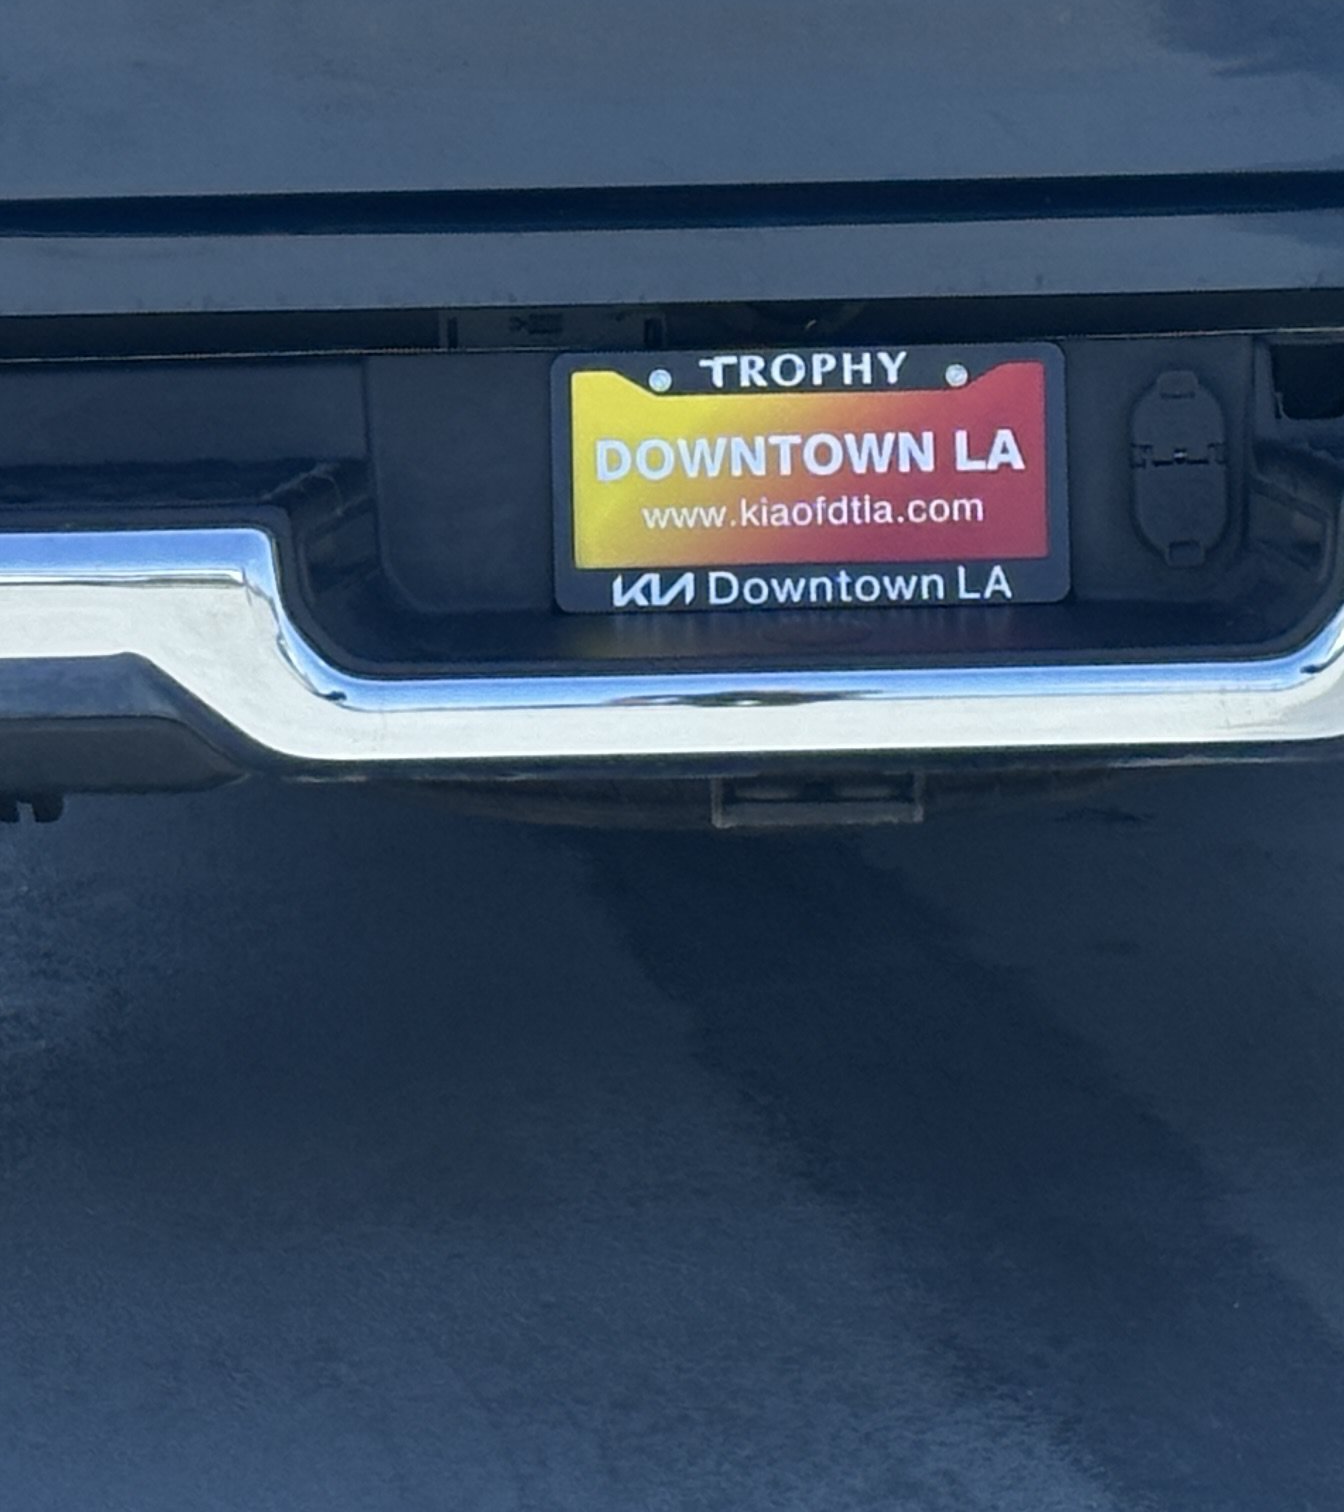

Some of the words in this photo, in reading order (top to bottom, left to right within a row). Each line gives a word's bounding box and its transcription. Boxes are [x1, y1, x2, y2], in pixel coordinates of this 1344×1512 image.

[699, 351, 907, 388] TROPHY
[596, 431, 935, 481] DOWNTOWN
[955, 428, 1025, 471] LA
[642, 495, 984, 529] www.kiaofdtla.com
[613, 571, 695, 607] KIA
[709, 568, 944, 605] Downtown
[958, 564, 1013, 600] LA
